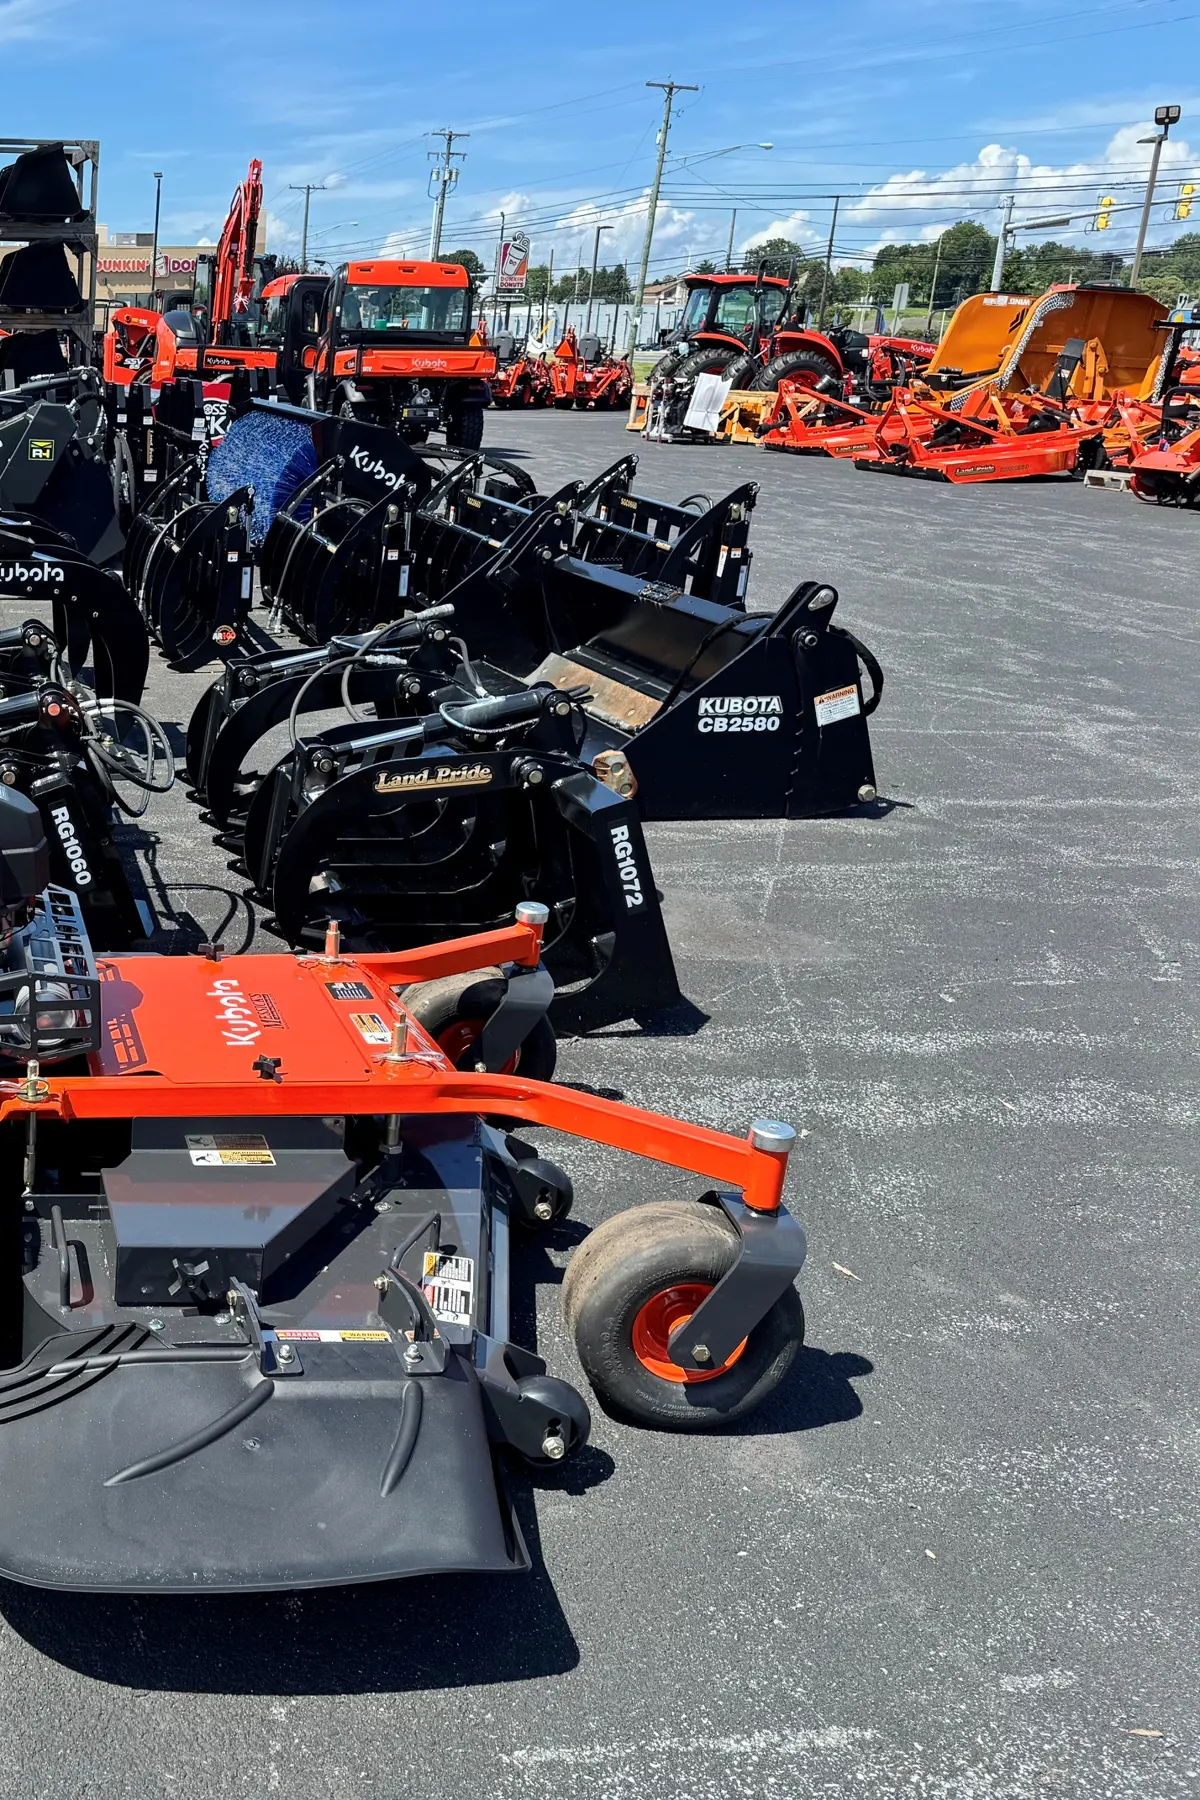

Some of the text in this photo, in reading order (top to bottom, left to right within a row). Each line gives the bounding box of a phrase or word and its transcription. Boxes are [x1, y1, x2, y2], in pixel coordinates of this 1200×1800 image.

[206, 357, 231, 366] Kubota
[411, 358, 448, 368] Kubota
[203, 404, 228, 415] OSS
[349, 445, 406, 491] Kubot
[825, 687, 855, 701] WARNING
[698, 696, 783, 715] KUBOTA
[697, 716, 780, 733] CB2580
[377, 764, 492, 788] Land Pride
[51, 806, 92, 886] RG1060
[610, 825, 644, 909] RG1072
[206, 979, 262, 1046] Kubota
